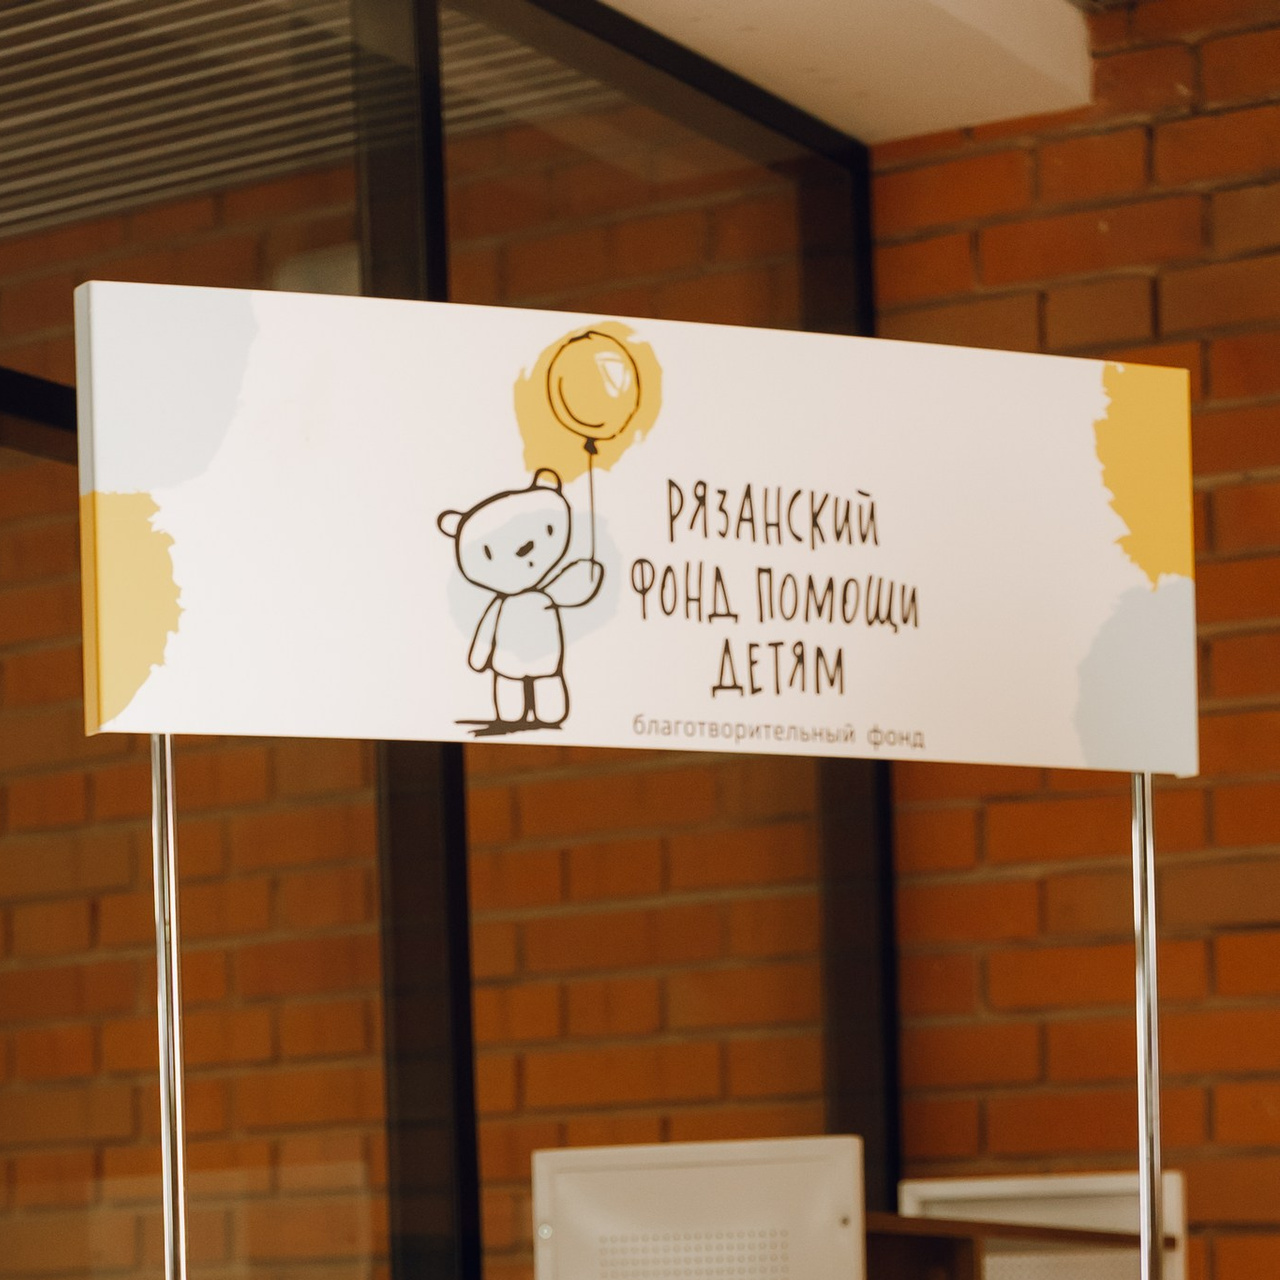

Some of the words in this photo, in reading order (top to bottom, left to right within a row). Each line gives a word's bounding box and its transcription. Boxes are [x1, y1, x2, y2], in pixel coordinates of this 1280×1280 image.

[666, 478, 880, 551] РЯЗАНСКИЙ
[630, 557, 739, 623] ФОНД
[756, 566, 920, 633] ПОМОЩИ
[711, 638, 846, 698] ДЕТЯМ
[632, 713, 857, 745] благотворительный
[866, 724, 927, 751] фонд
